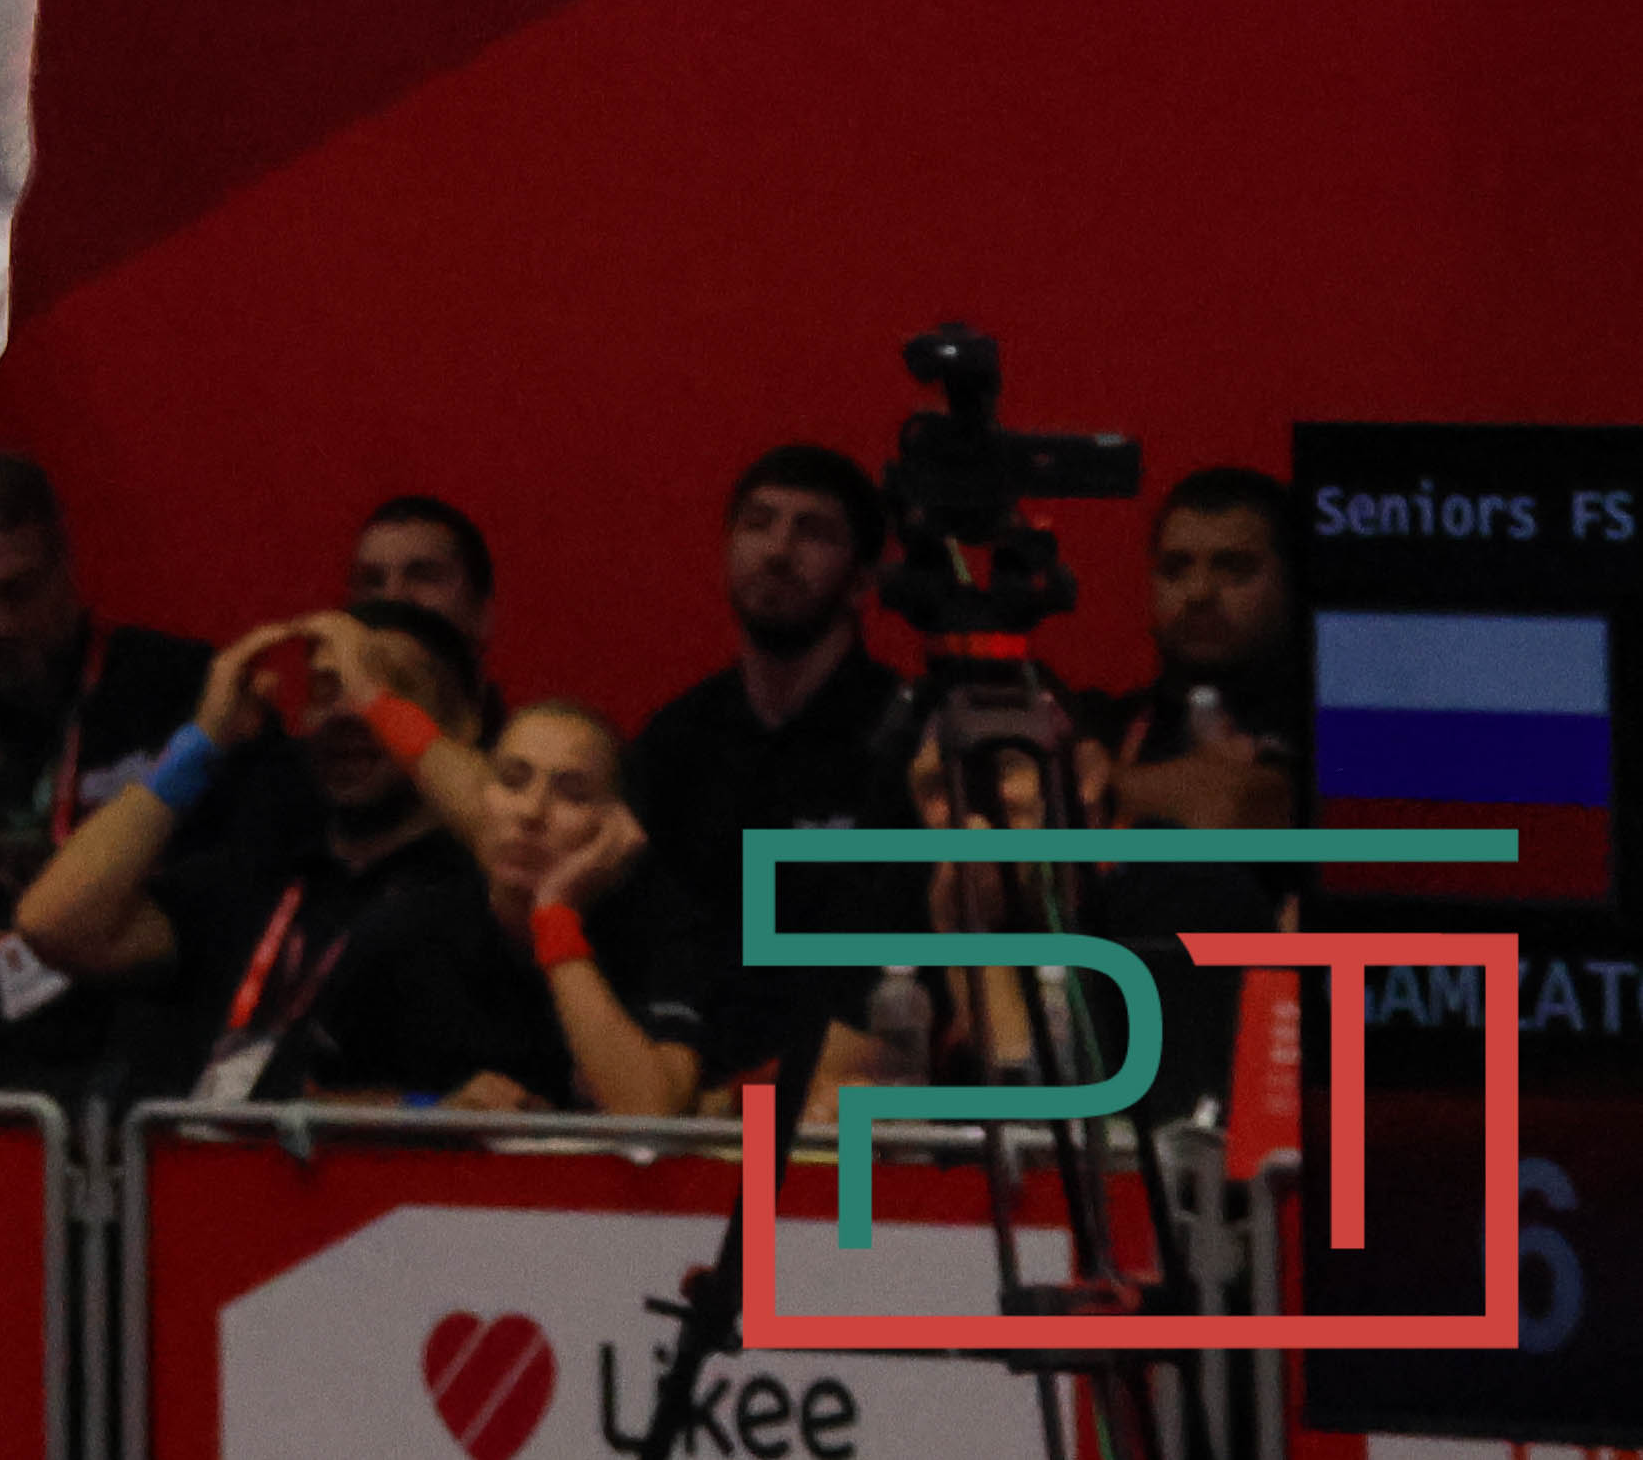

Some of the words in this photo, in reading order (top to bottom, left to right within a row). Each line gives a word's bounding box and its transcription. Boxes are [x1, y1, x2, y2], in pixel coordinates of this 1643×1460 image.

[1315, 479, 1537, 541] Seniors
[1571, 490, 1637, 542] FS
[1324, 958, 1643, 1033] AMAT
[1481, 1157, 1585, 1354] 6
